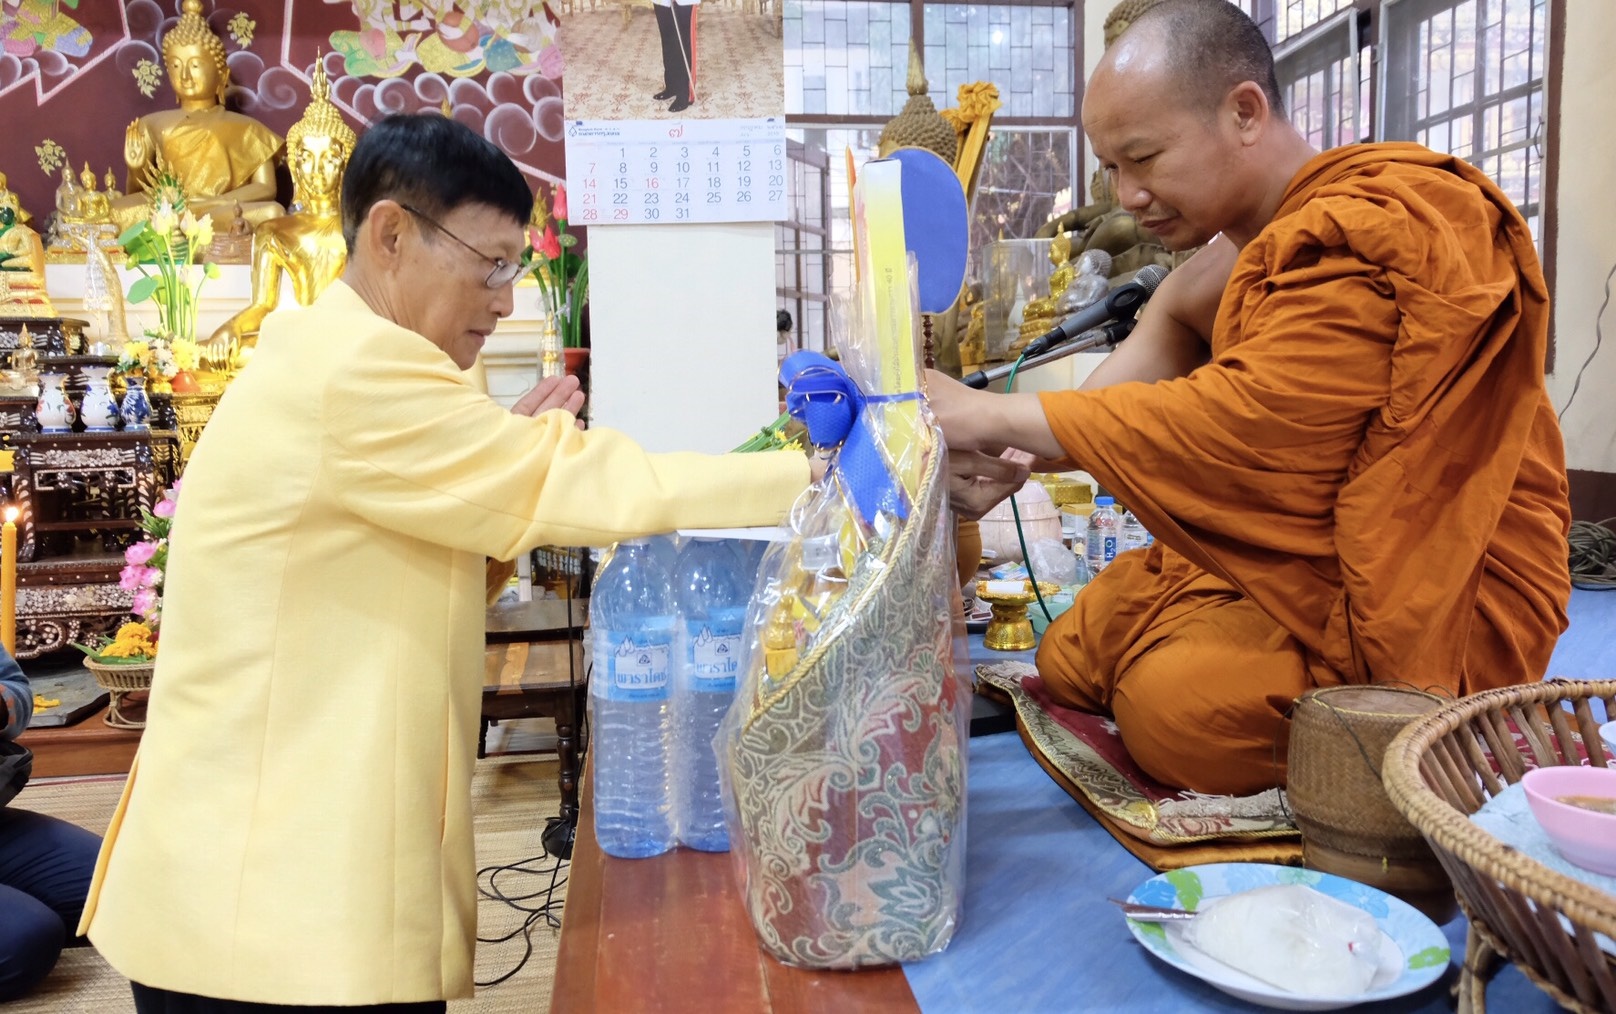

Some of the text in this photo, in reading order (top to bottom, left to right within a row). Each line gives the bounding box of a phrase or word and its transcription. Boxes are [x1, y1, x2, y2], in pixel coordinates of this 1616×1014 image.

[668, 125, 683, 138] ๗
[619, 144, 782, 159] 1 2 3 4 5 6
[589, 160, 782, 174] 7 8 9 10 11 12 13
[583, 175, 783, 189] 14 15 16 17 18 19 20
[583, 190, 782, 204] 21 22 23 24 25 26 27
[583, 208, 689, 220] 28 29 30 31
